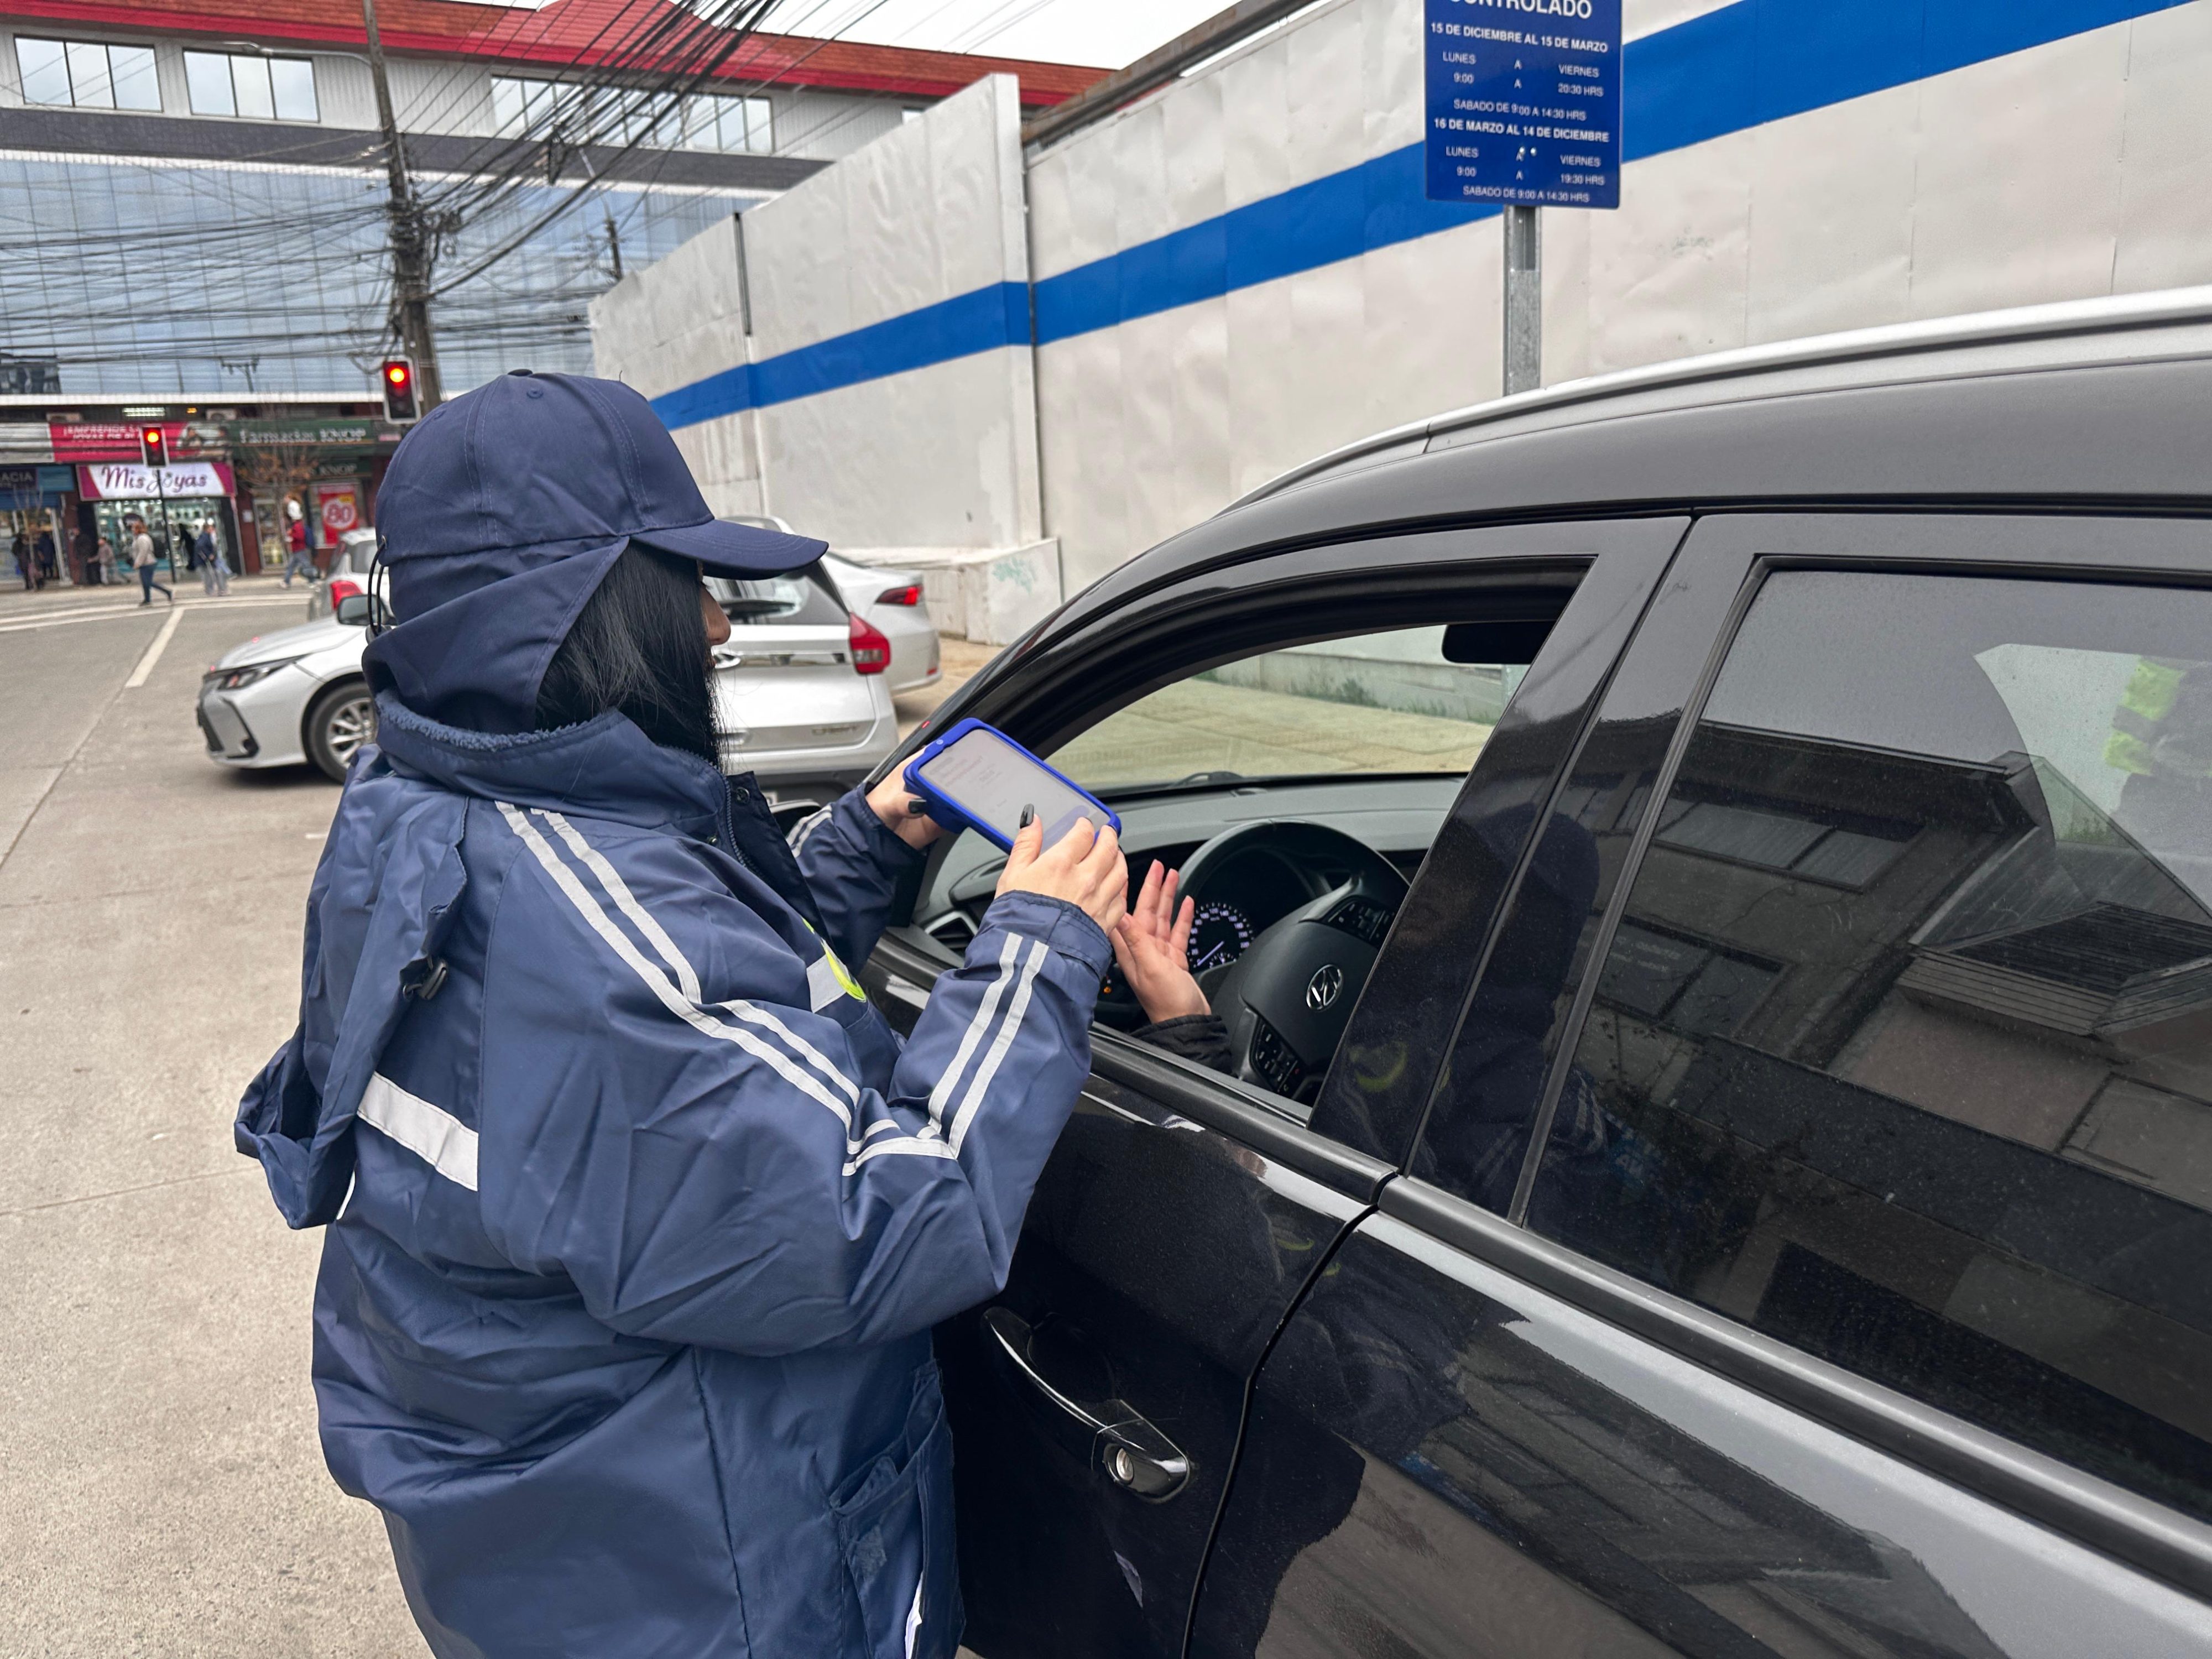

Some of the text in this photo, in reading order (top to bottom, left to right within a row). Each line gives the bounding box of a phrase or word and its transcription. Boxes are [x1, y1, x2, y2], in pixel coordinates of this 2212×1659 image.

[1431, 22, 1608, 53] 15 DE DICIEMBRE AL 15 DE MARZO
[1442, 51, 1600, 78] LUNES A VIERNES
[1453, 72, 1604, 97] 9:00 A 20:30 HRS
[1453, 98, 1494, 112] SABADO
[1496, 101, 1510, 113] DE
[1511, 103, 1531, 116] 9:00
[1532, 106, 1540, 117] A
[1566, 109, 1587, 122] HRS
[1434, 117, 1610, 143] 16 DE MARZO AL 14 DE DICIEMBRE
[1446, 145, 1479, 158] LUNES
[1559, 154, 1601, 168] VIERNES
[1457, 166, 1477, 177] 9:00
[1516, 170, 1524, 180] A
[1585, 175, 1605, 186] HRS
[1463, 185, 1502, 197] SABADO
[1503, 187, 1516, 198] DE
[1517, 189, 1536, 200] 9:00
[1537, 190, 1544, 200] A
[1570, 192, 1590, 203] HRS
[101, 465, 146, 489] Mis
